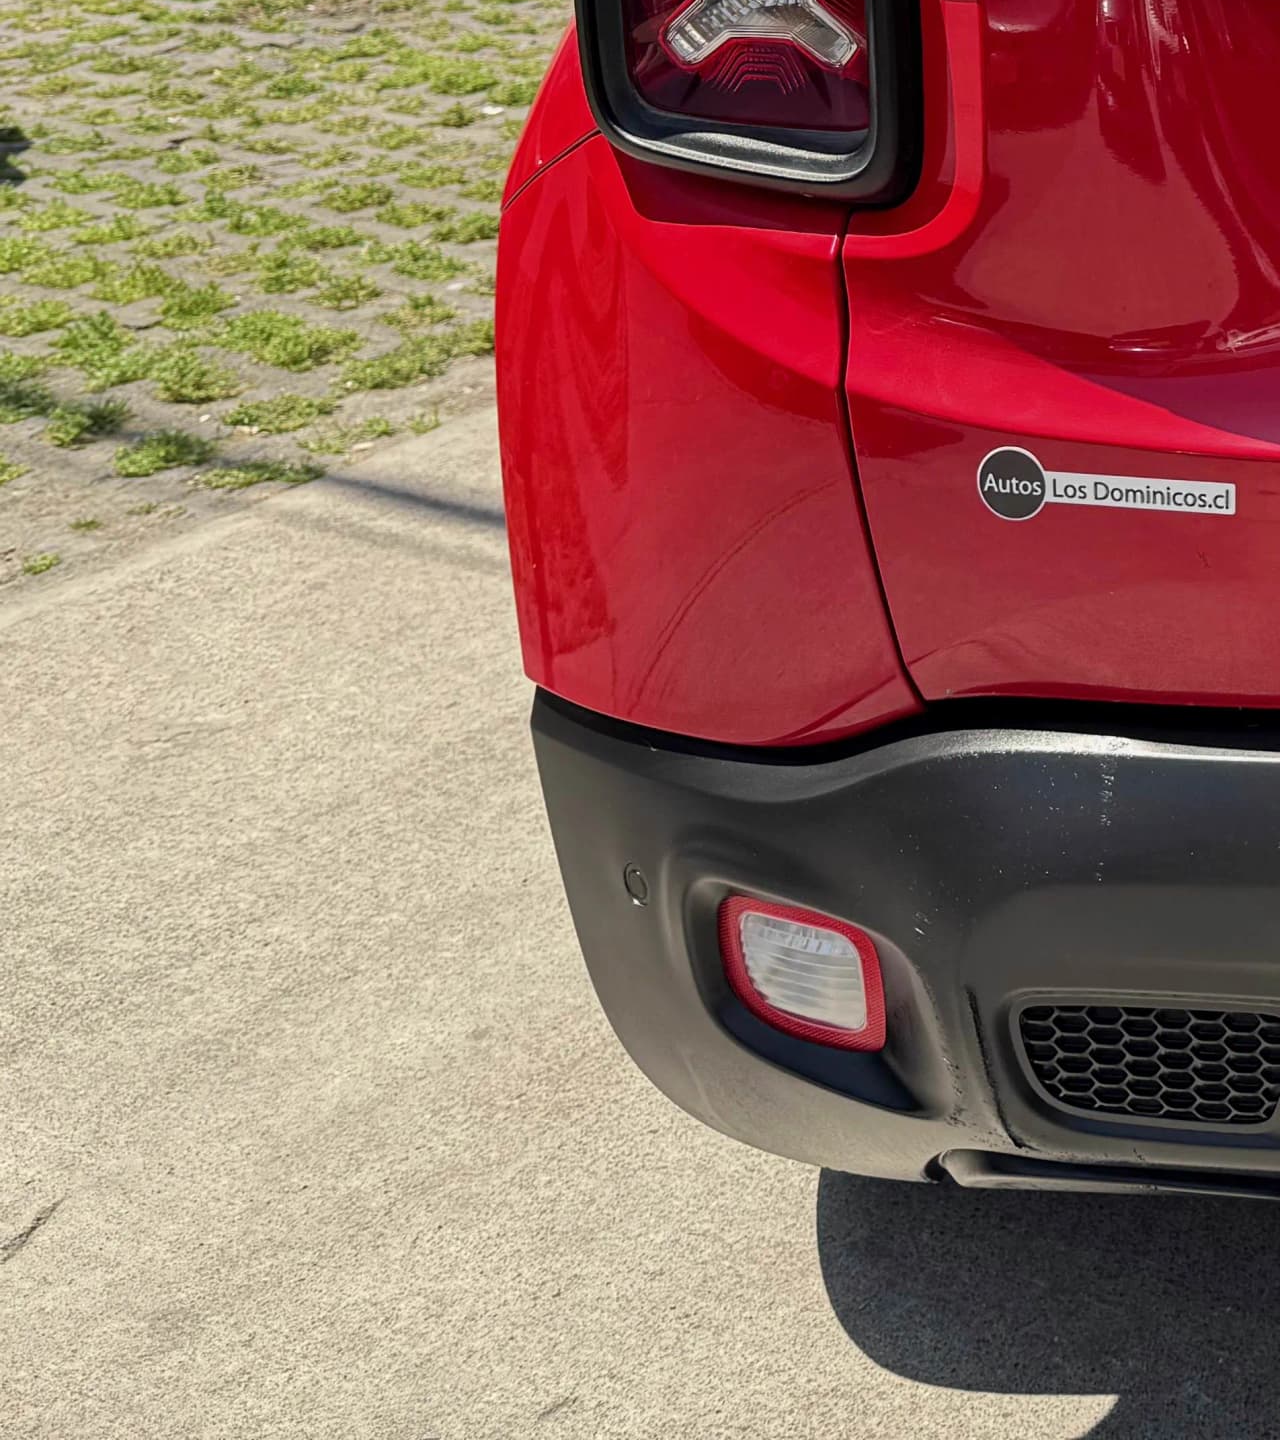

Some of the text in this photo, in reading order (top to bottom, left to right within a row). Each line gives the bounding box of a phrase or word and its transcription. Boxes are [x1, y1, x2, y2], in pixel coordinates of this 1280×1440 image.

[983, 473, 1230, 510] Autos Los Dominicos.cl
